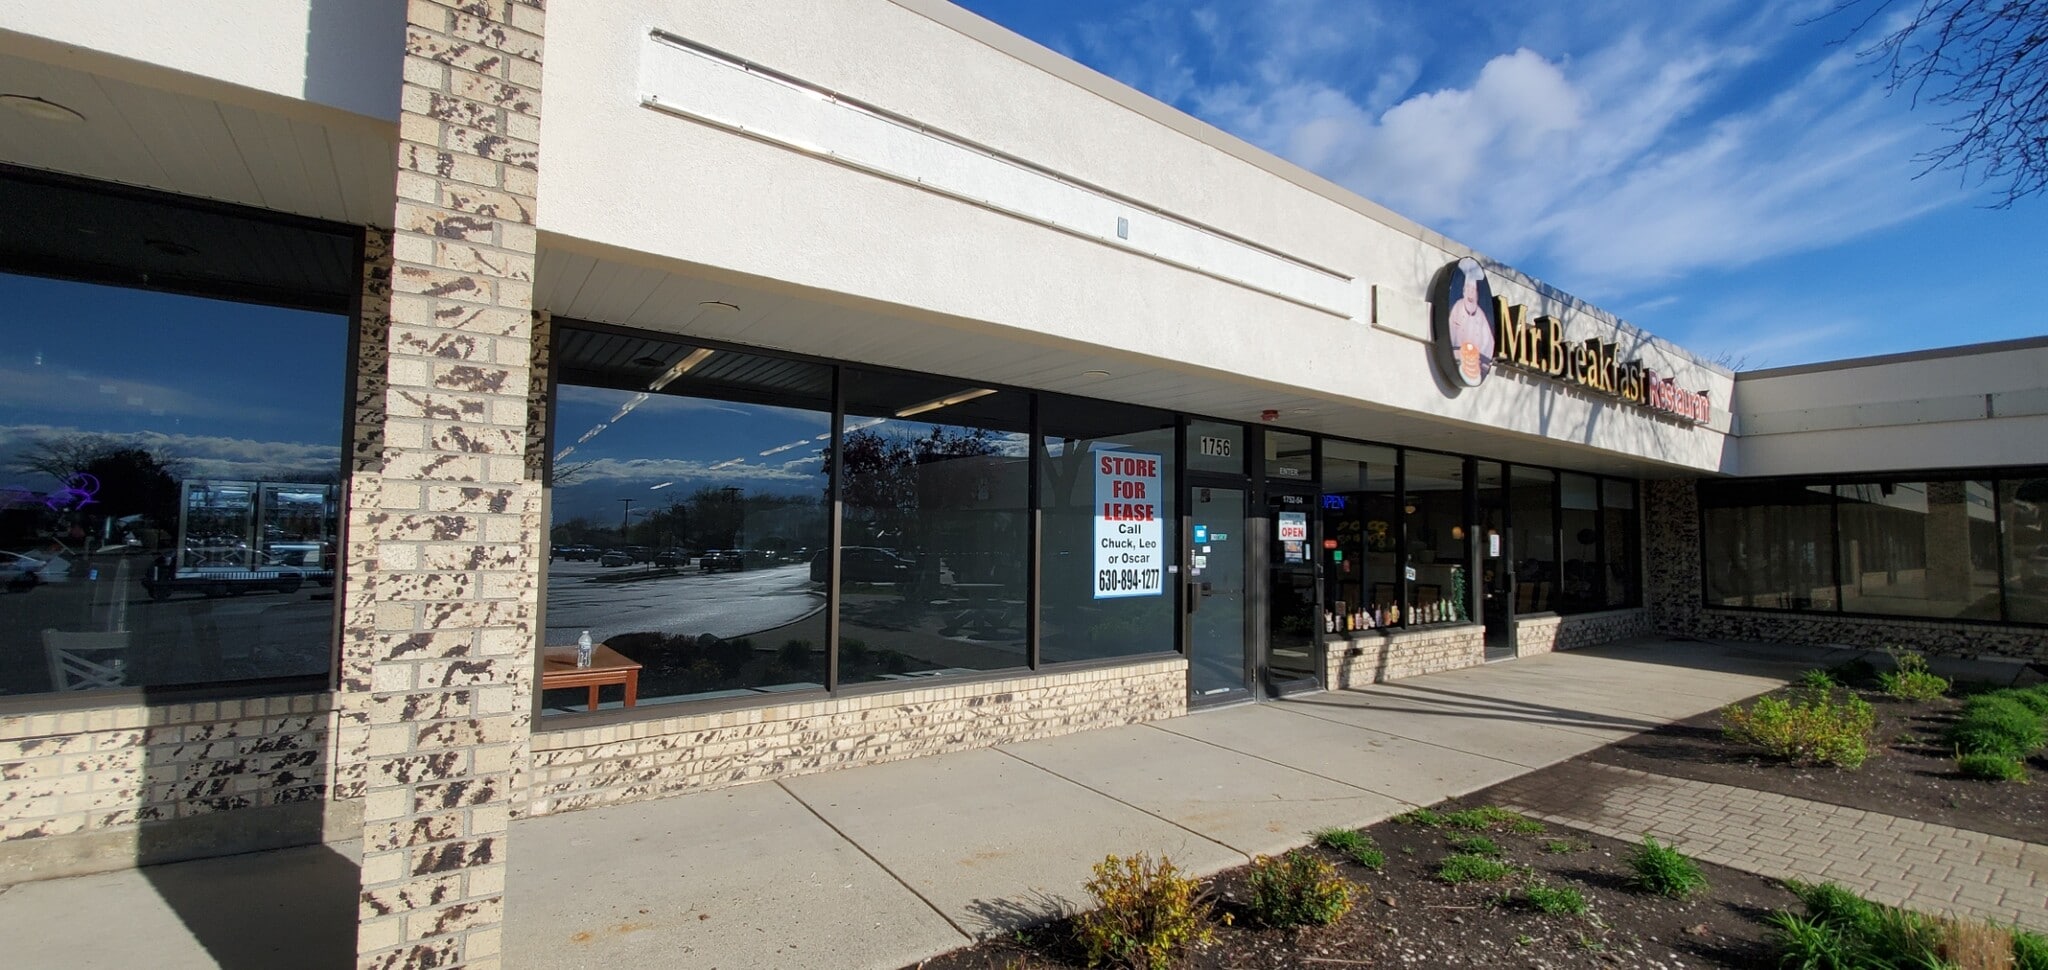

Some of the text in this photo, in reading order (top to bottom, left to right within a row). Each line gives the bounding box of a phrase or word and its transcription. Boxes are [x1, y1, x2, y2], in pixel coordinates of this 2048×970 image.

[1649, 371, 1711, 424] Restaurant
[1202, 438, 1230, 456] 1756
[1101, 456, 1157, 478] STORE
[1279, 467, 1299, 476] ENTER
[1113, 480, 1146, 499] FOR
[1104, 503, 1154, 522] LEASE
[1118, 524, 1141, 534] Call
[1281, 527, 1304, 538] OPEN
[1101, 538, 1157, 550] Chuck, Leo
[1108, 553, 1151, 564] or Oscar
[1099, 568, 1160, 592] 630-894-1277
